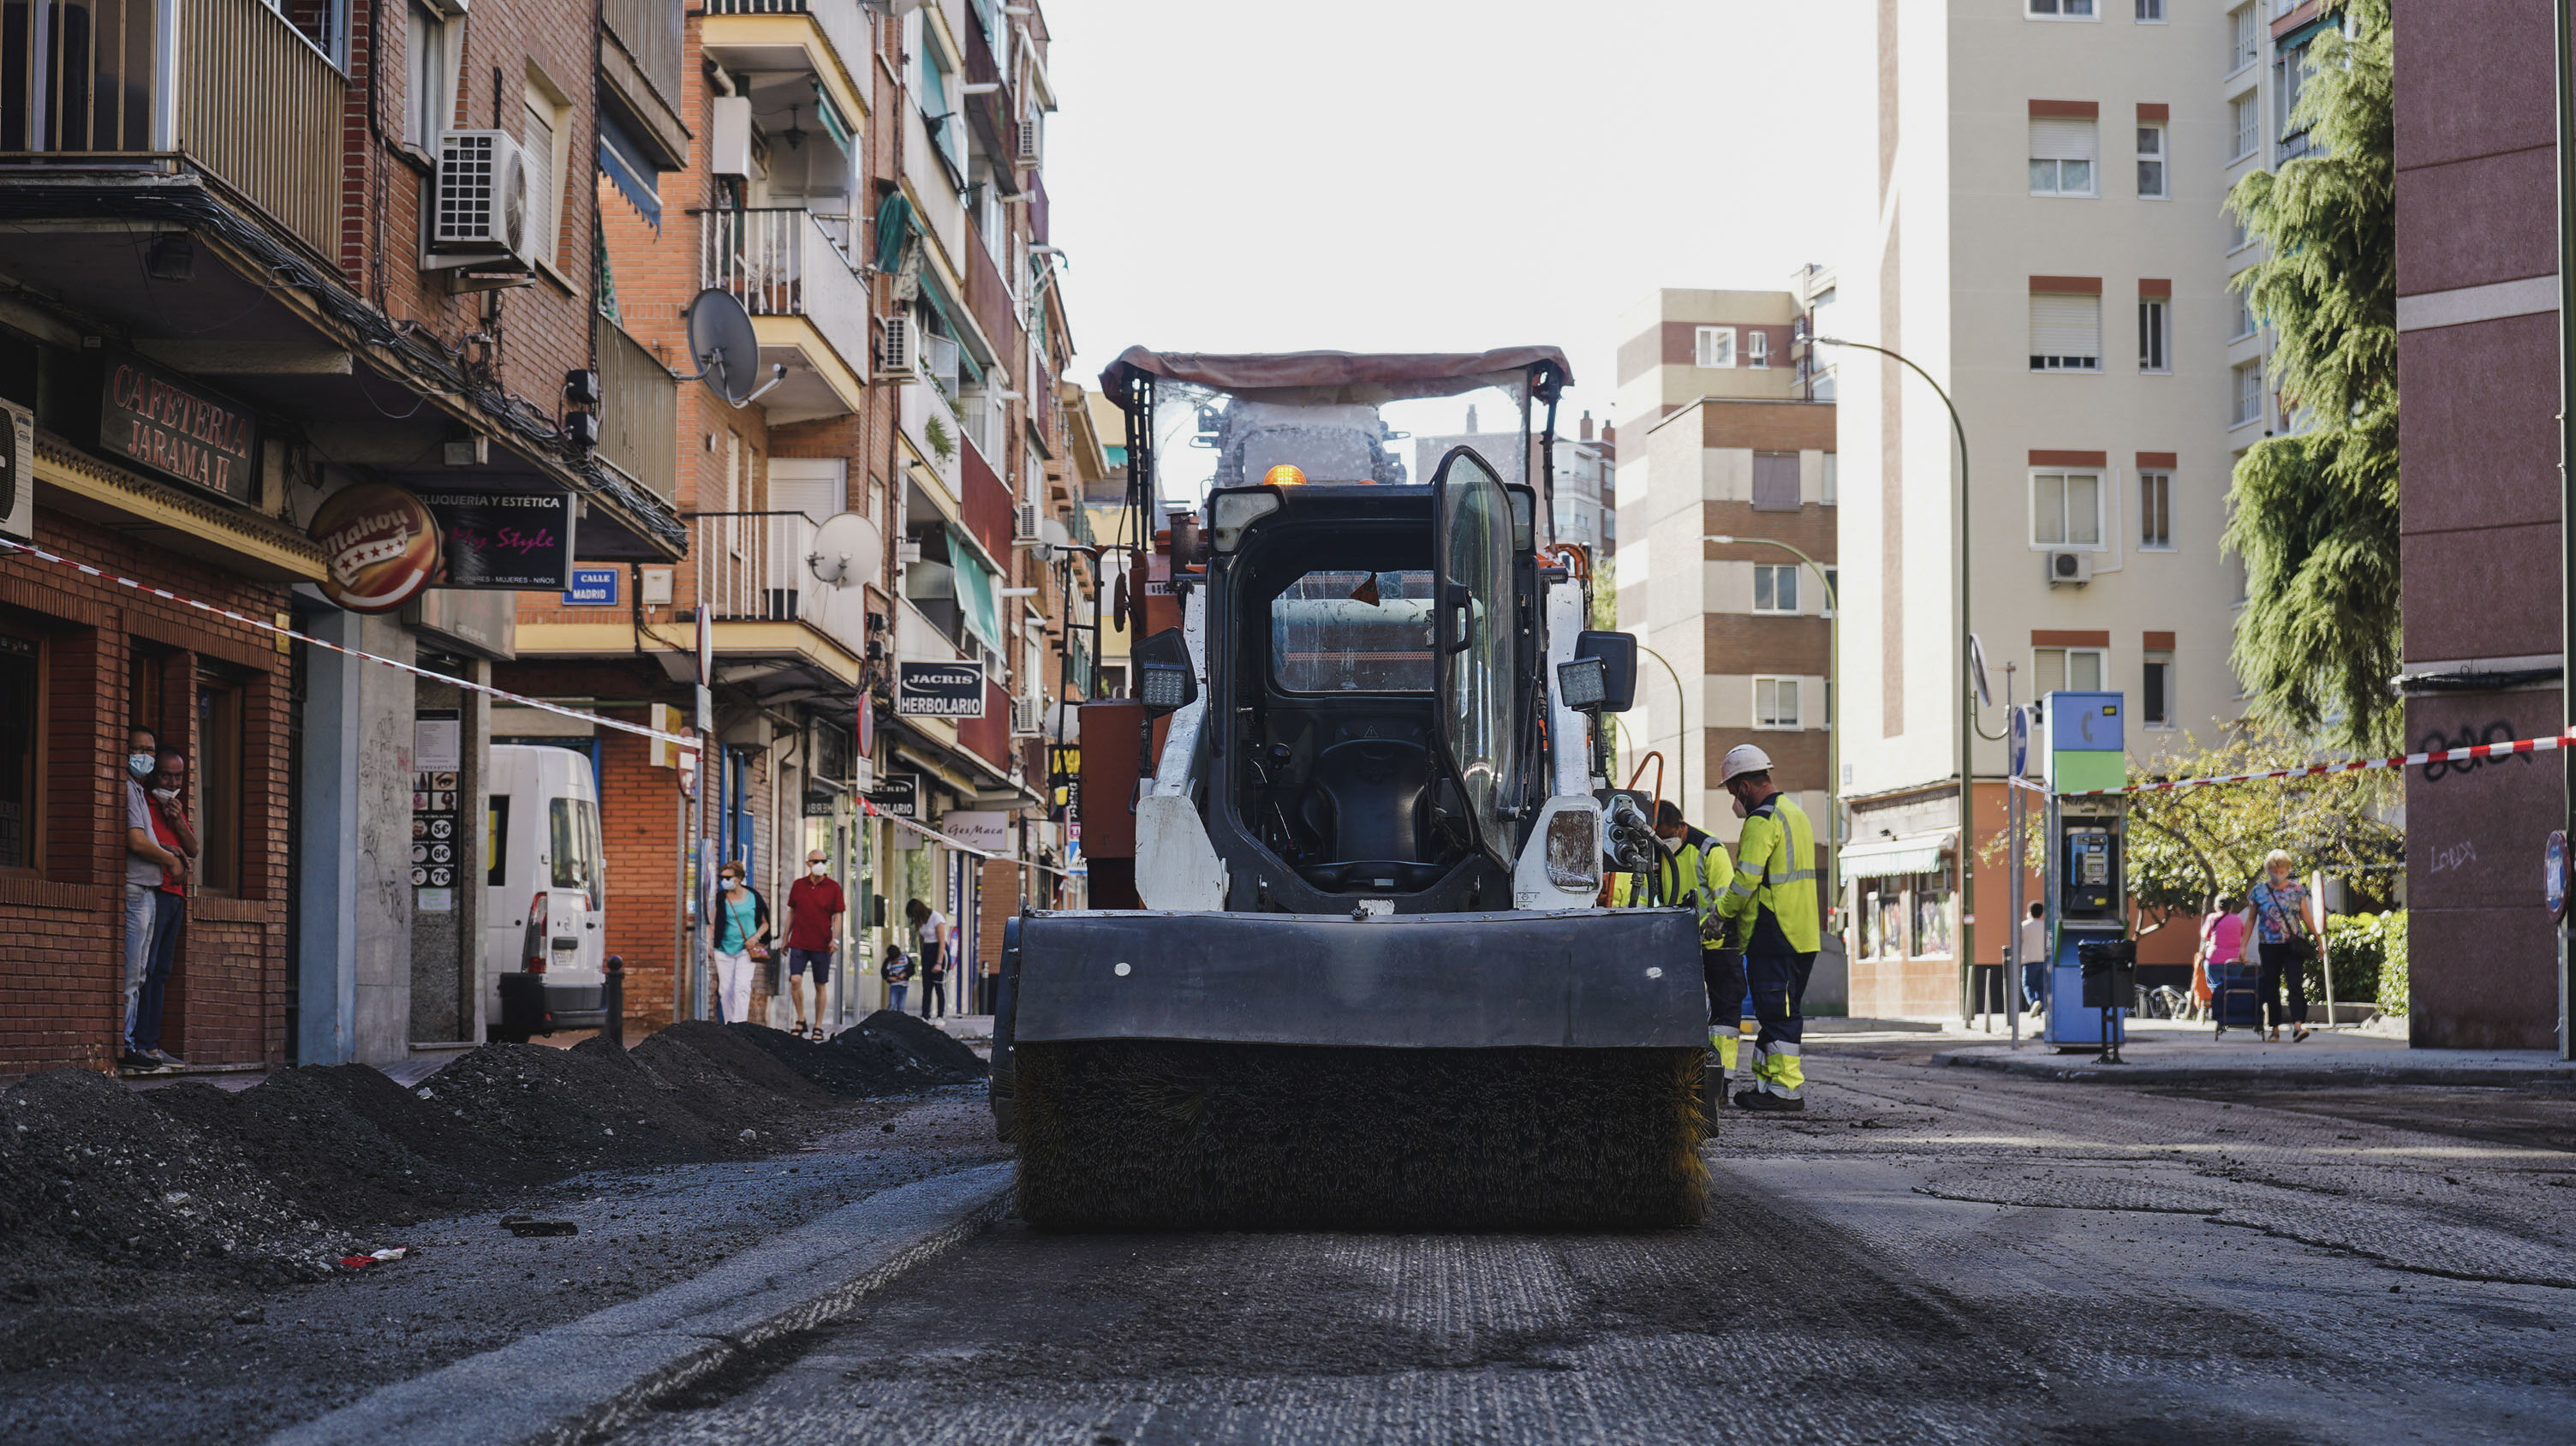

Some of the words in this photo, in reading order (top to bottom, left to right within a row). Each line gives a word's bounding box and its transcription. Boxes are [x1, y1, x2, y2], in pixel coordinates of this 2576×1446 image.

[114, 365, 247, 458] CAFETERIA
[128, 420, 210, 486] JARAMA
[492, 496, 499, 506] Y
[501, 493, 560, 508] ESTÉTICA
[496, 527, 555, 555] Style
[495, 576, 528, 584] MUJERES
[534, 576, 555, 585] NIÑOS
[581, 573, 611, 583] CALLE
[572, 589, 606, 599] MADRID
[909, 674, 973, 684] JACRIS
[901, 696, 981, 714] HERBOLARIO
[433, 823, 450, 835] 5€
[433, 848, 449, 859] 6€
[433, 872, 449, 882] 7€
